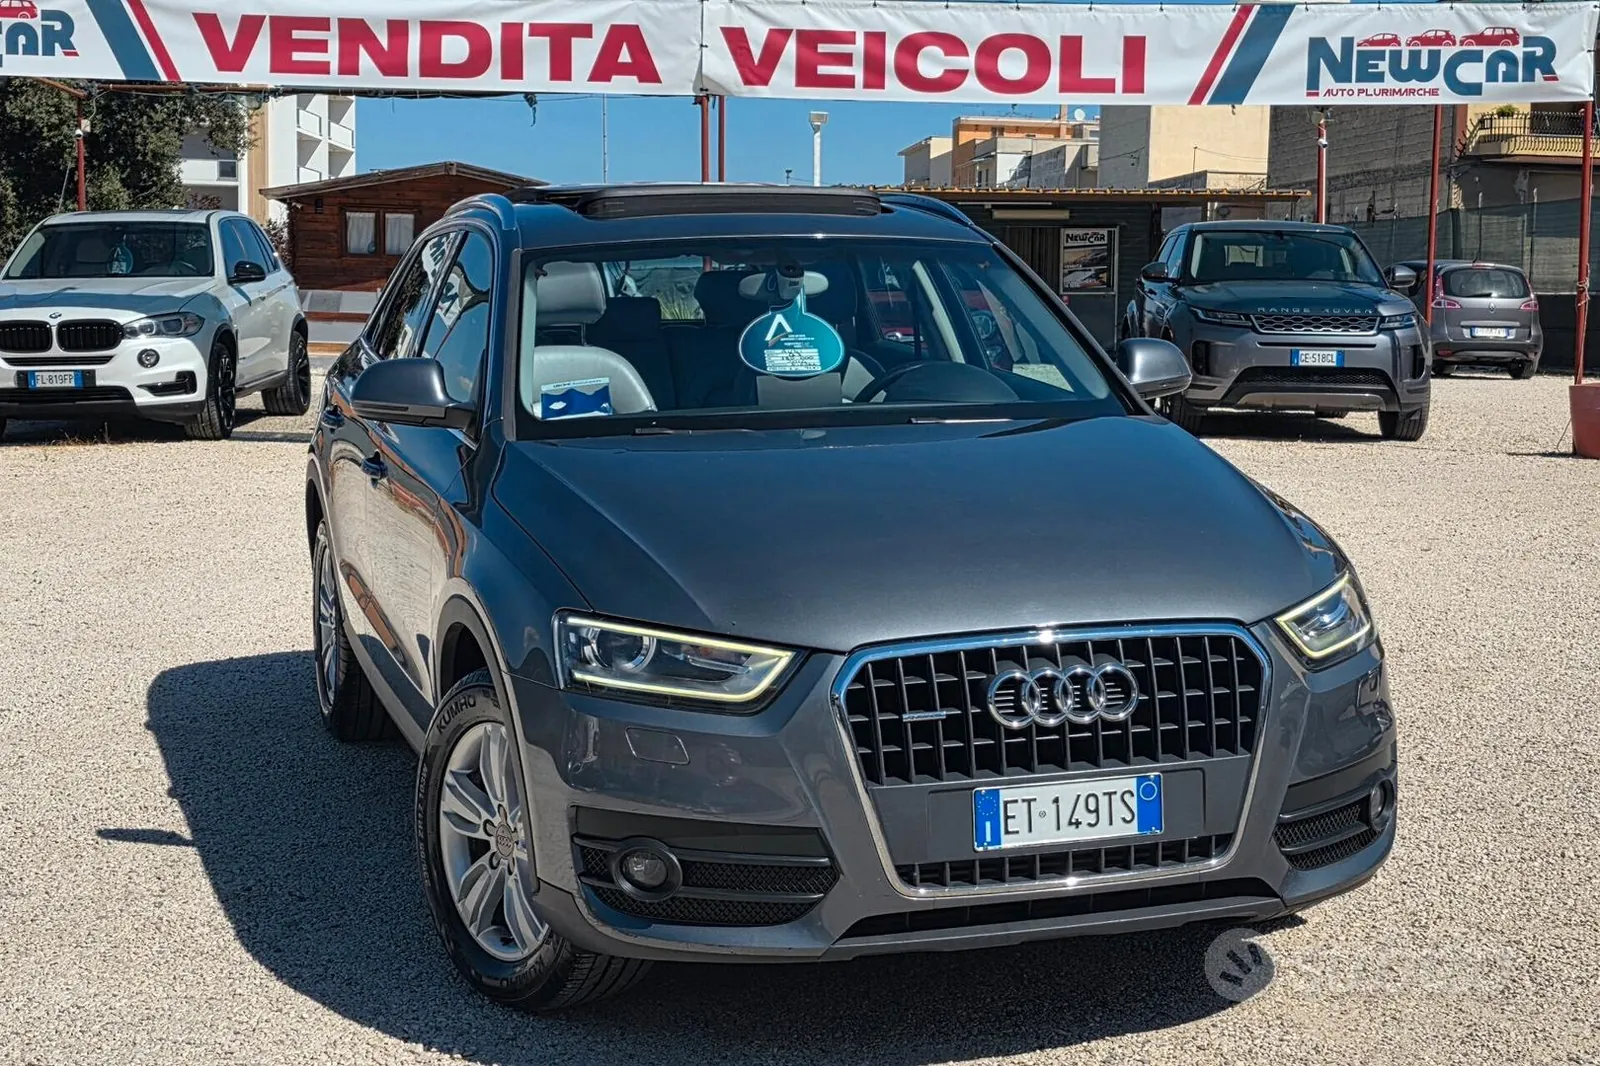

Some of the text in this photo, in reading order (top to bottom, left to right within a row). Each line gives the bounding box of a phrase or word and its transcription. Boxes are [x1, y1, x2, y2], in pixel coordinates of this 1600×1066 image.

[0, 9, 80, 68] AR
[193, 12, 662, 84] VENDITA
[721, 27, 1145, 95] VEICOLI
[1323, 88, 1440, 97] AUTO PLURIMARCHE
[436, 694, 477, 735] KUMHO
[1003, 798, 1037, 836] ET
[1052, 789, 1136, 832] 149TS
